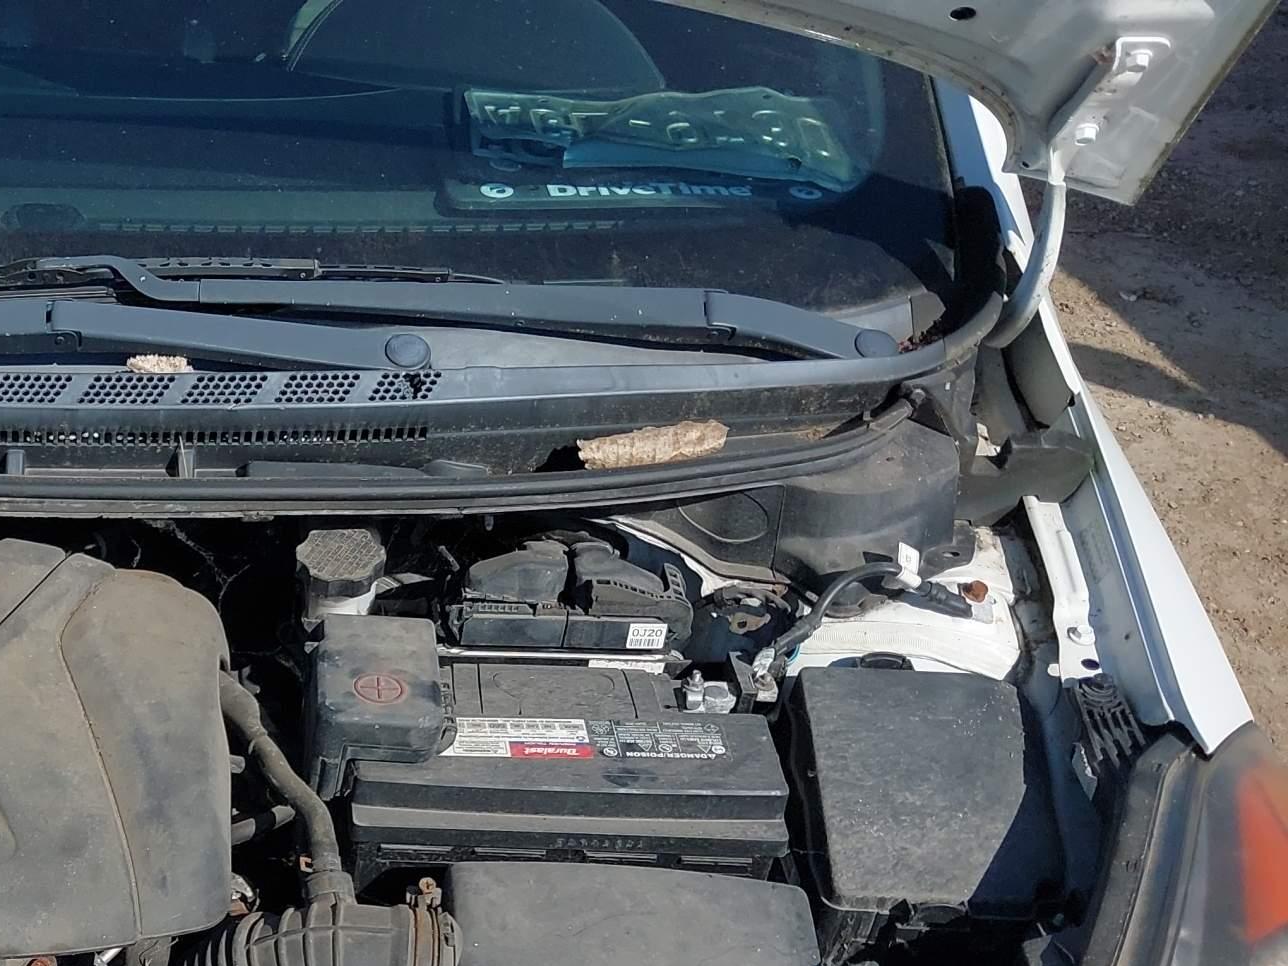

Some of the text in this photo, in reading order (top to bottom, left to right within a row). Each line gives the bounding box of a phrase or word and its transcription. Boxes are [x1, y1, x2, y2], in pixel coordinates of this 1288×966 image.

[546, 182, 753, 197] DriveTime
[524, 746, 580, 756] Duralast
[626, 751, 709, 760] DANGER/POISON
